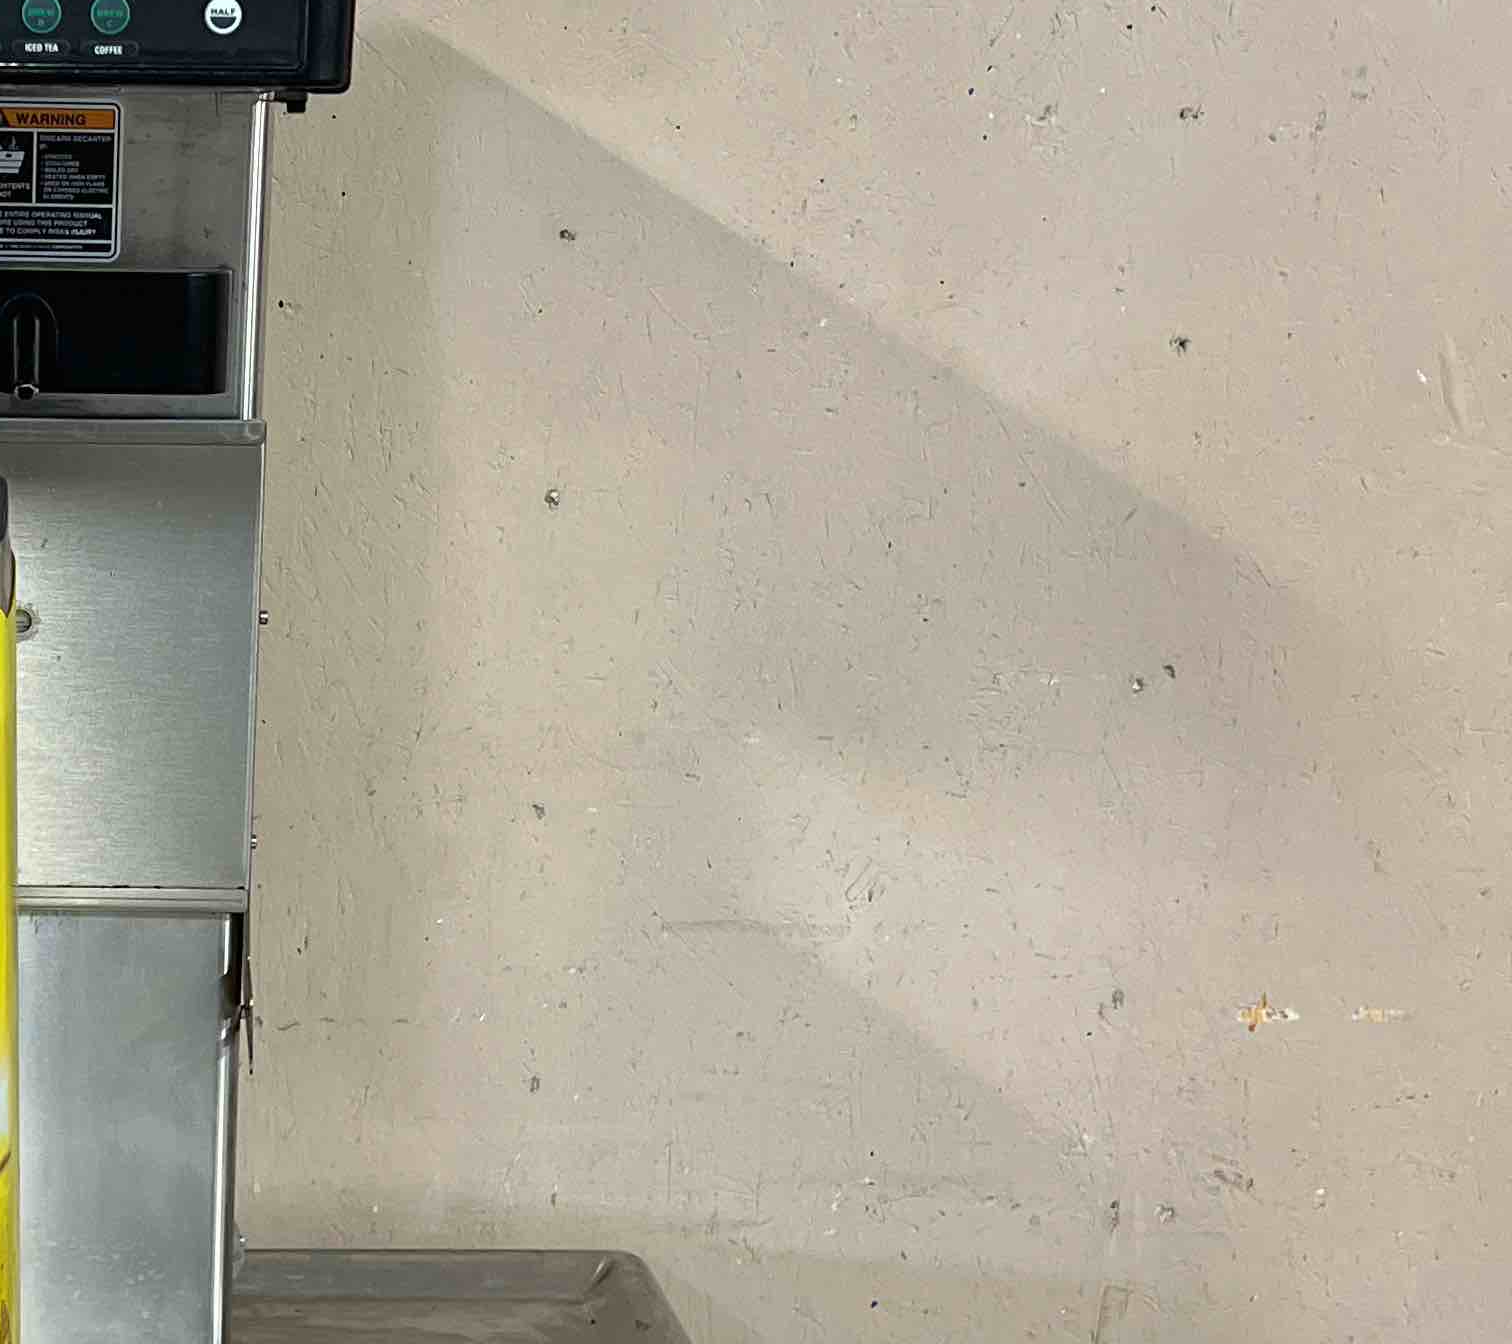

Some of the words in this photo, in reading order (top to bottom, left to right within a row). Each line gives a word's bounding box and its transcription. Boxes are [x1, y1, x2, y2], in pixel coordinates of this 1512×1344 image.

[210, 8, 236, 16] HALF
[25, 43, 43, 53] ICED
[44, 43, 59, 53] TEA
[94, 45, 123, 55] COFFEE
[15, 112, 87, 126] WARNING
